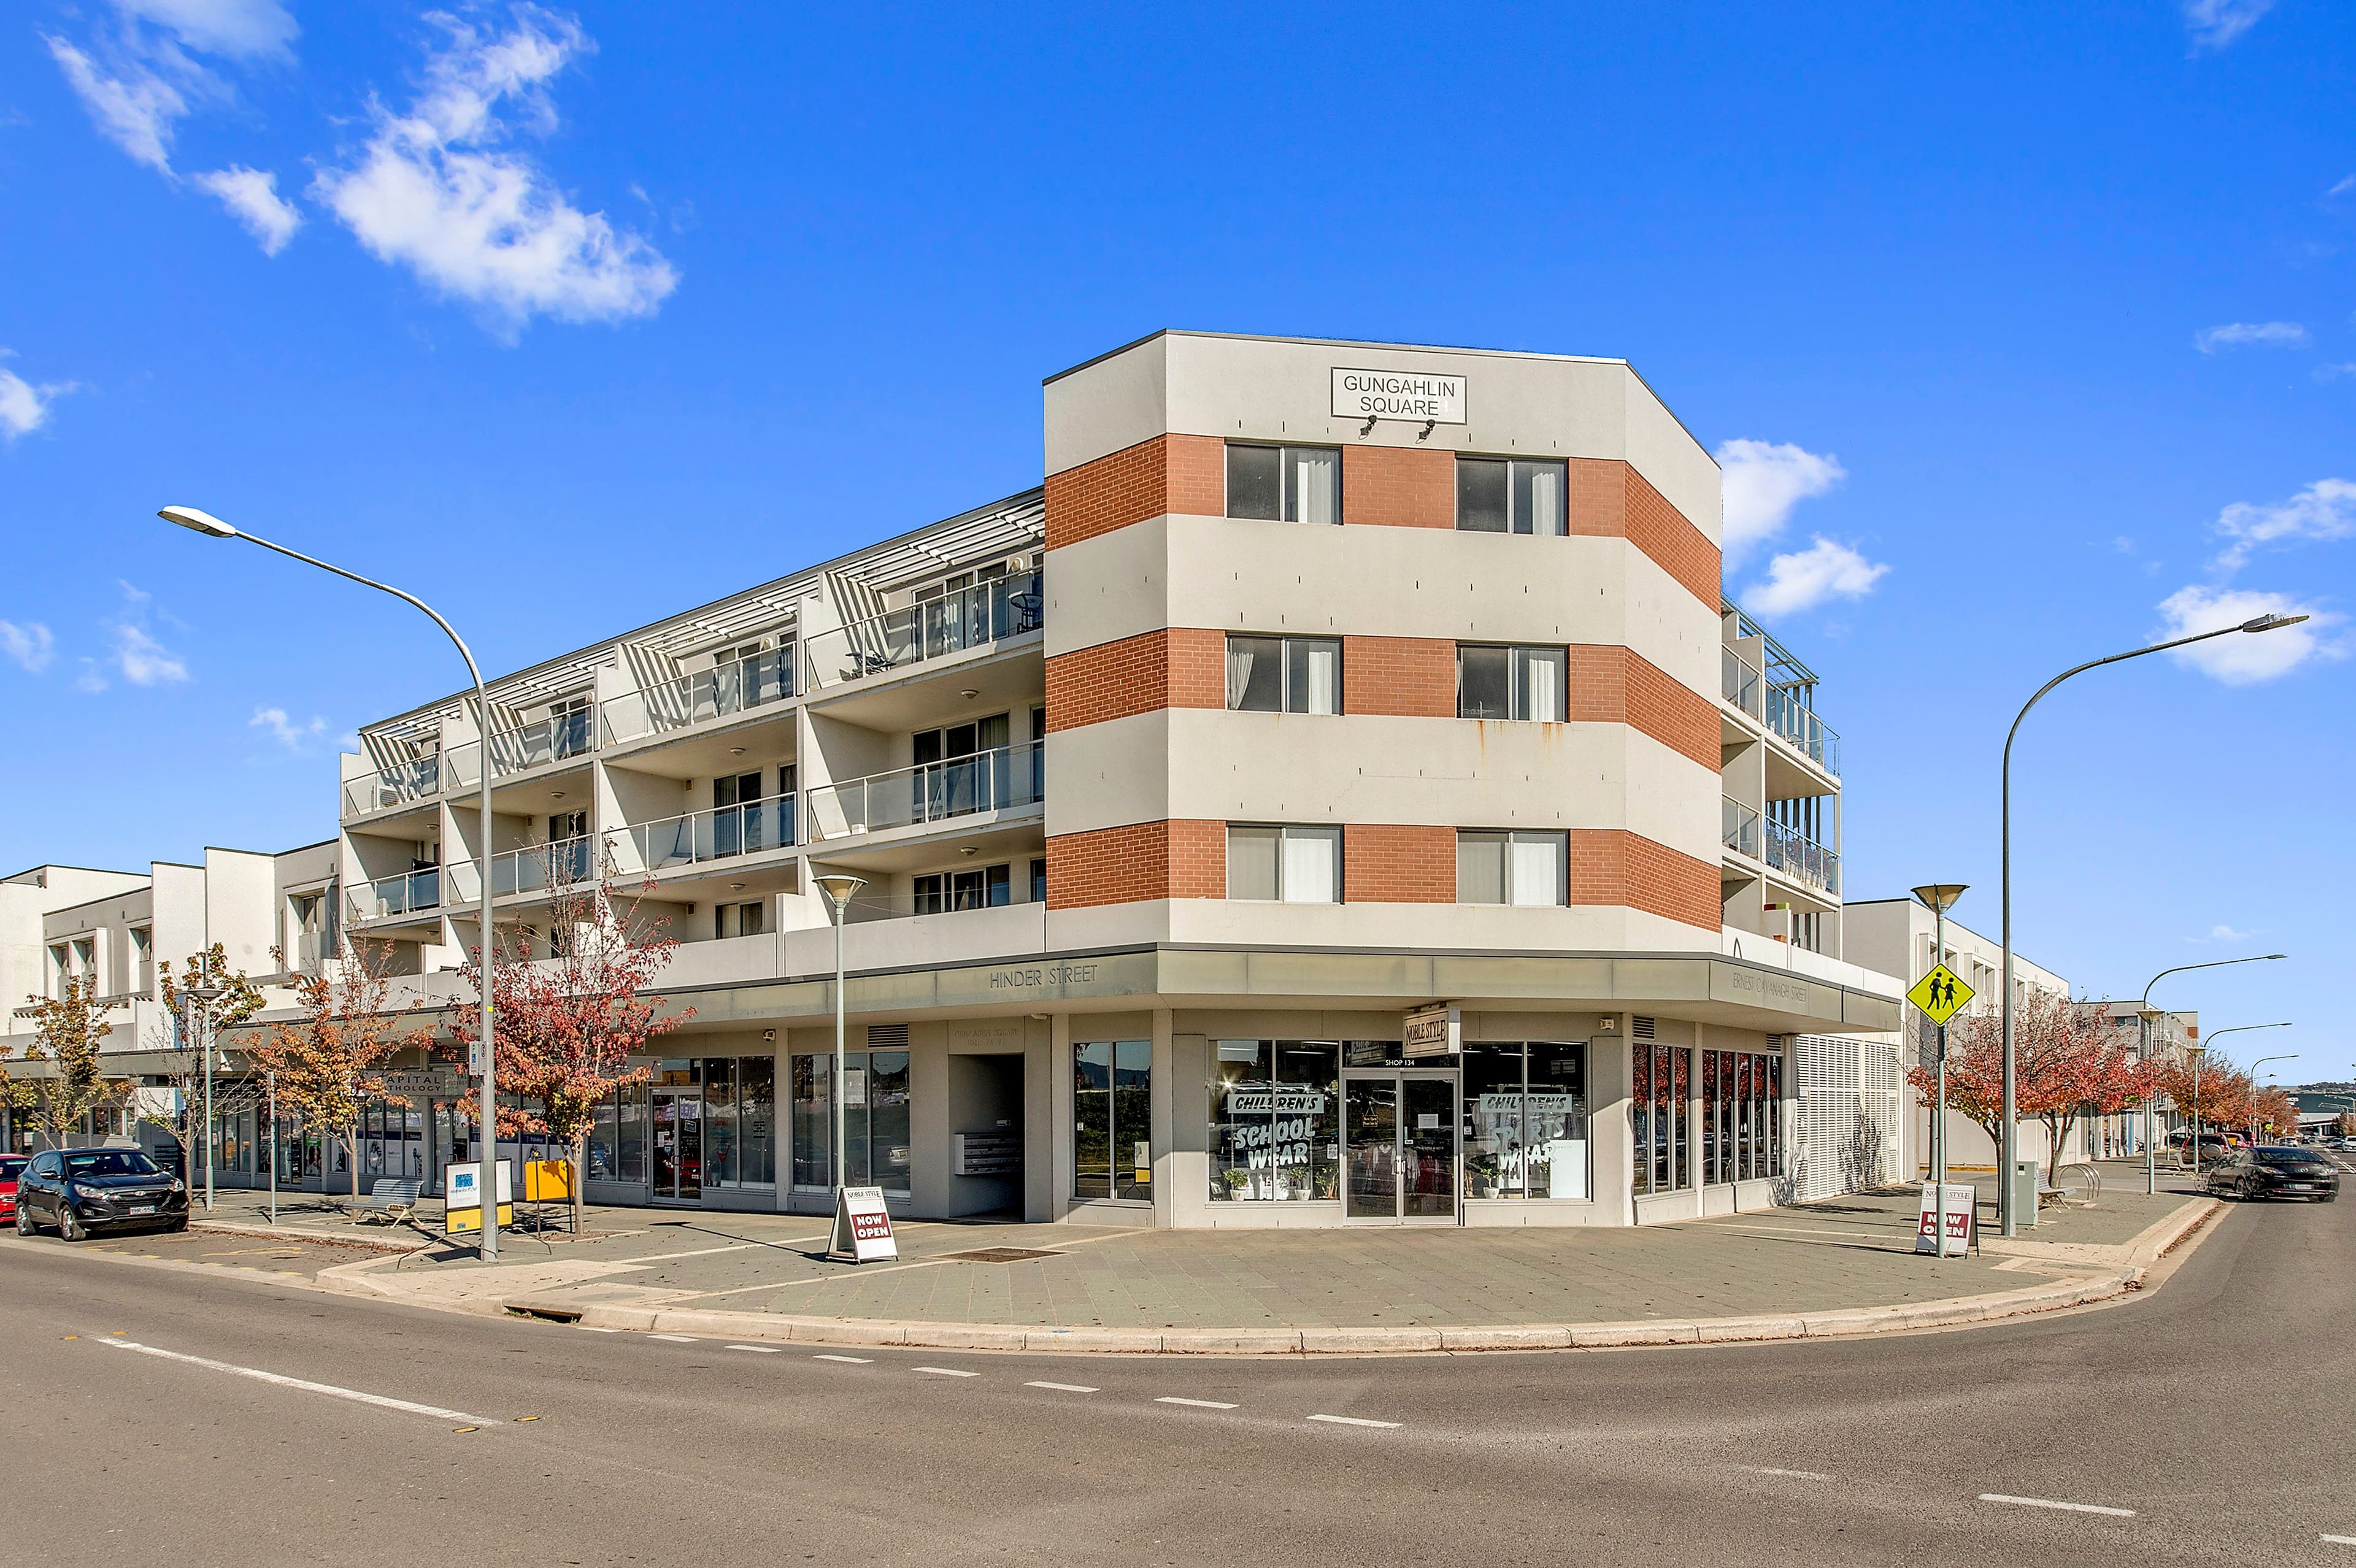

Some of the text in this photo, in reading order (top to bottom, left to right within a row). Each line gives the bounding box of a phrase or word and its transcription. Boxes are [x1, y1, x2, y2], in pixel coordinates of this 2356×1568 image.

[1344, 375, 1455, 398] GUNGAHLIN
[1360, 396, 1439, 416] SQUARE
[990, 964, 1098, 988] HINDER STREET
[1733, 972, 1754, 991] ERNEST
[1756, 977, 1790, 1000] CAVANAGH
[1406, 1020, 1446, 1046] NOBLE STYLE
[387, 1075, 441, 1085] APITAL
[1235, 1096, 1319, 1110] CHILDREN'S
[1235, 1118, 1315, 1149] SCHOOL
[1491, 1116, 1565, 1151] SPORTS
[1248, 1142, 1309, 1170] WEAR
[1499, 1142, 1557, 1169] WEAR
[1949, 1191, 1971, 1200] STYLE
[856, 1215, 882, 1226] NOW
[1927, 1213, 1963, 1224] NW
[857, 1226, 889, 1238] OPEN
[1922, 1224, 1965, 1236] OEN
